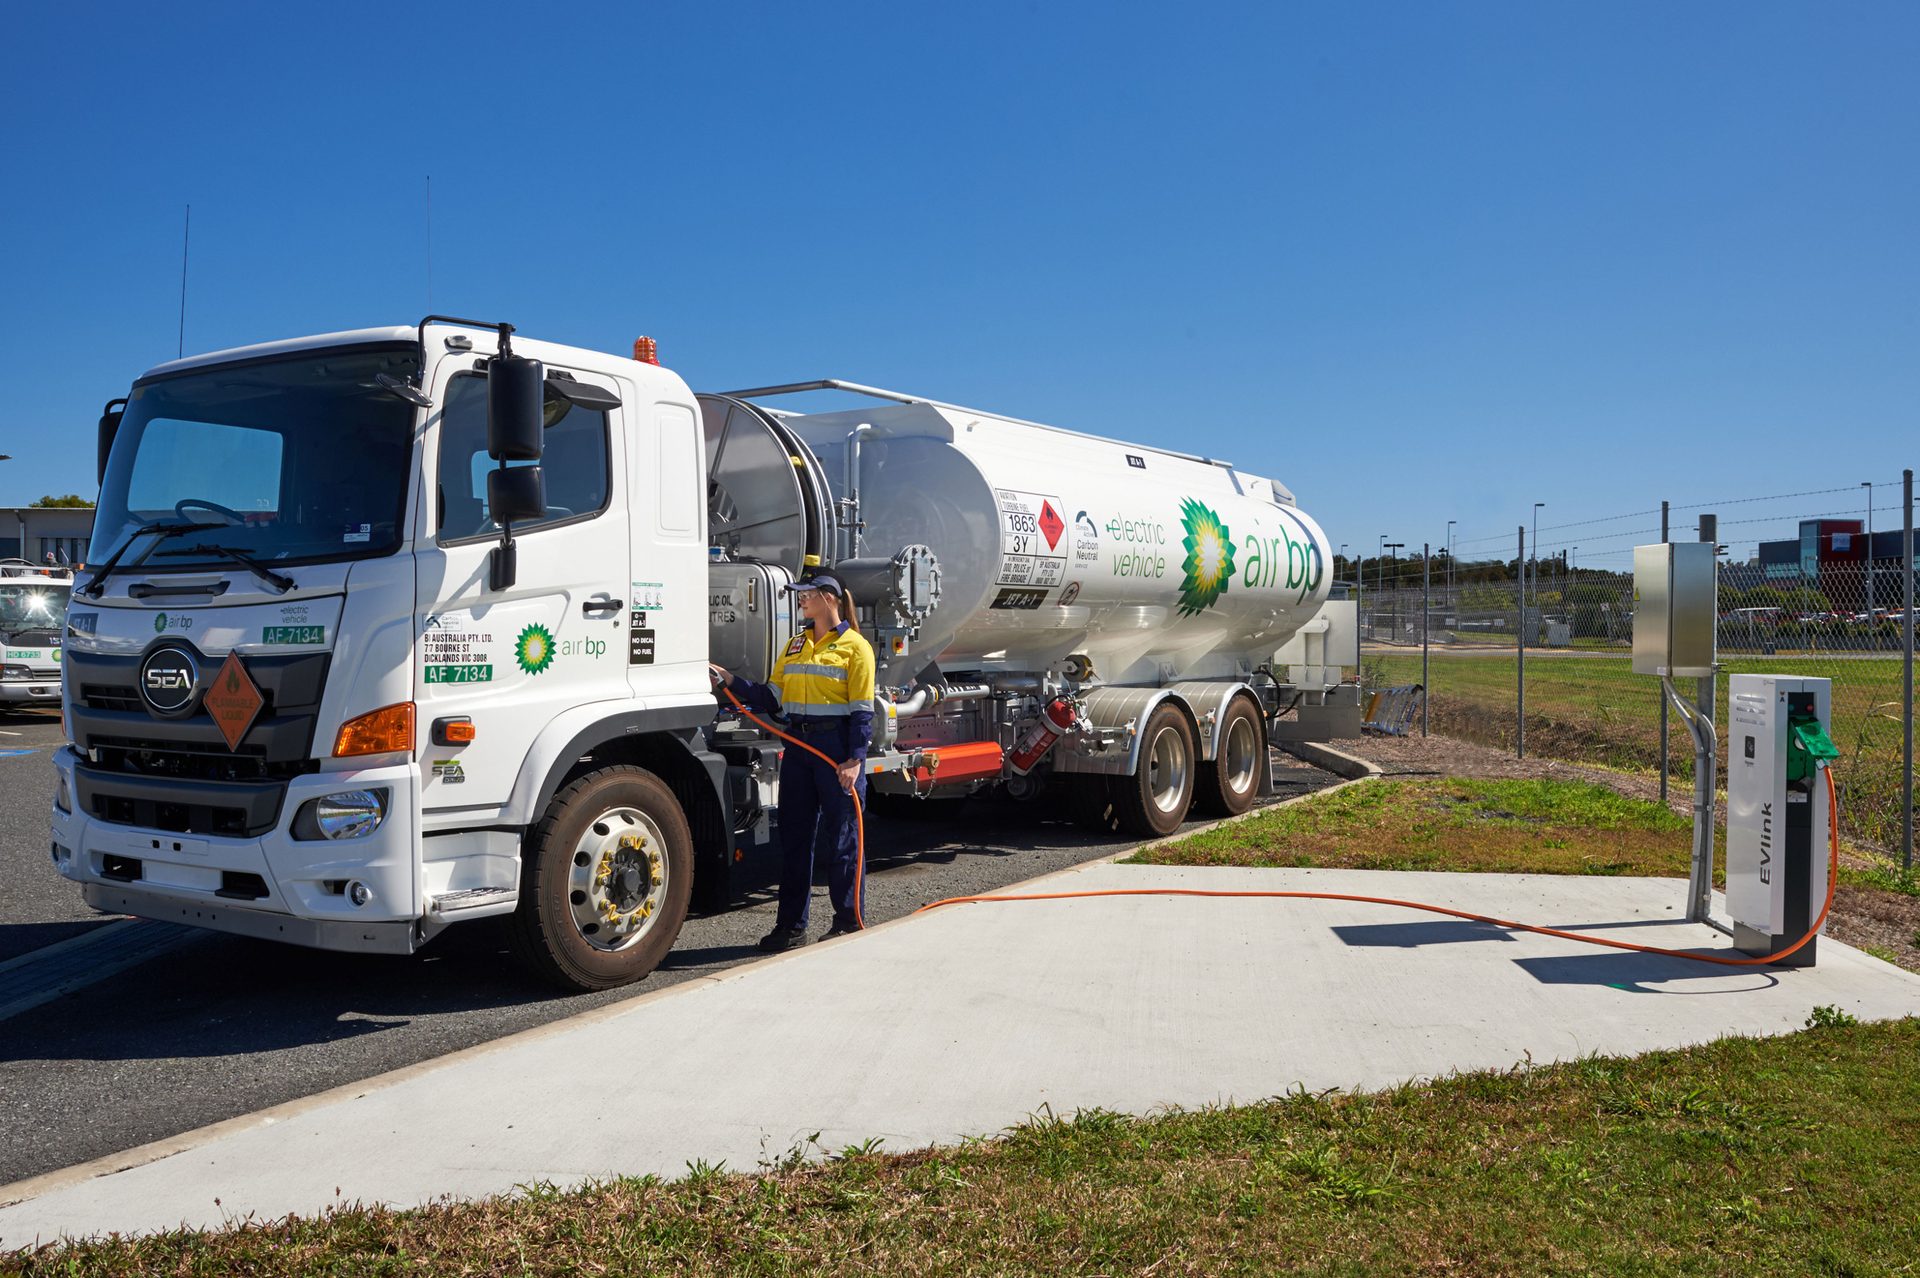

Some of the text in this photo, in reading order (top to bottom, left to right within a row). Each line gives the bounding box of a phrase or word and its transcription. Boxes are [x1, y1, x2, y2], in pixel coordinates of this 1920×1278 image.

[1009, 514, 1036, 533] 1863
[1109, 511, 1165, 545] electric
[1013, 535, 1029, 553] 3Y
[1076, 539, 1099, 550] Carbon
[1076, 550, 1099, 561] Neutral
[1113, 547, 1165, 579] vehicle
[1243, 518, 1324, 606] air bp
[721, 595, 733, 606] OIL
[1002, 593, 1020, 606] JET
[281, 606, 309, 614] electric
[168, 615, 193, 631] air bp
[281, 615, 308, 624] vehicle
[267, 627, 320, 643] AF 7134
[432, 634, 466, 642] AUSTRALIA
[467, 634, 480, 642] PTY.
[481, 634, 494, 642] LTD.
[435, 644, 461, 652] BOURKE
[462, 644, 470, 652] ST
[561, 635, 606, 660] air bp
[461, 654, 472, 662] VIC
[472, 653, 488, 662] 3008
[147, 668, 192, 689] SEA
[429, 666, 488, 682] AF 7134
[212, 697, 255, 709] FLAMMABLE
[221, 710, 244, 721] LIQUID
[231, 729, 235, 739] 3
[431, 766, 465, 776] SEA
[1760, 803, 1772, 885] EVlink
